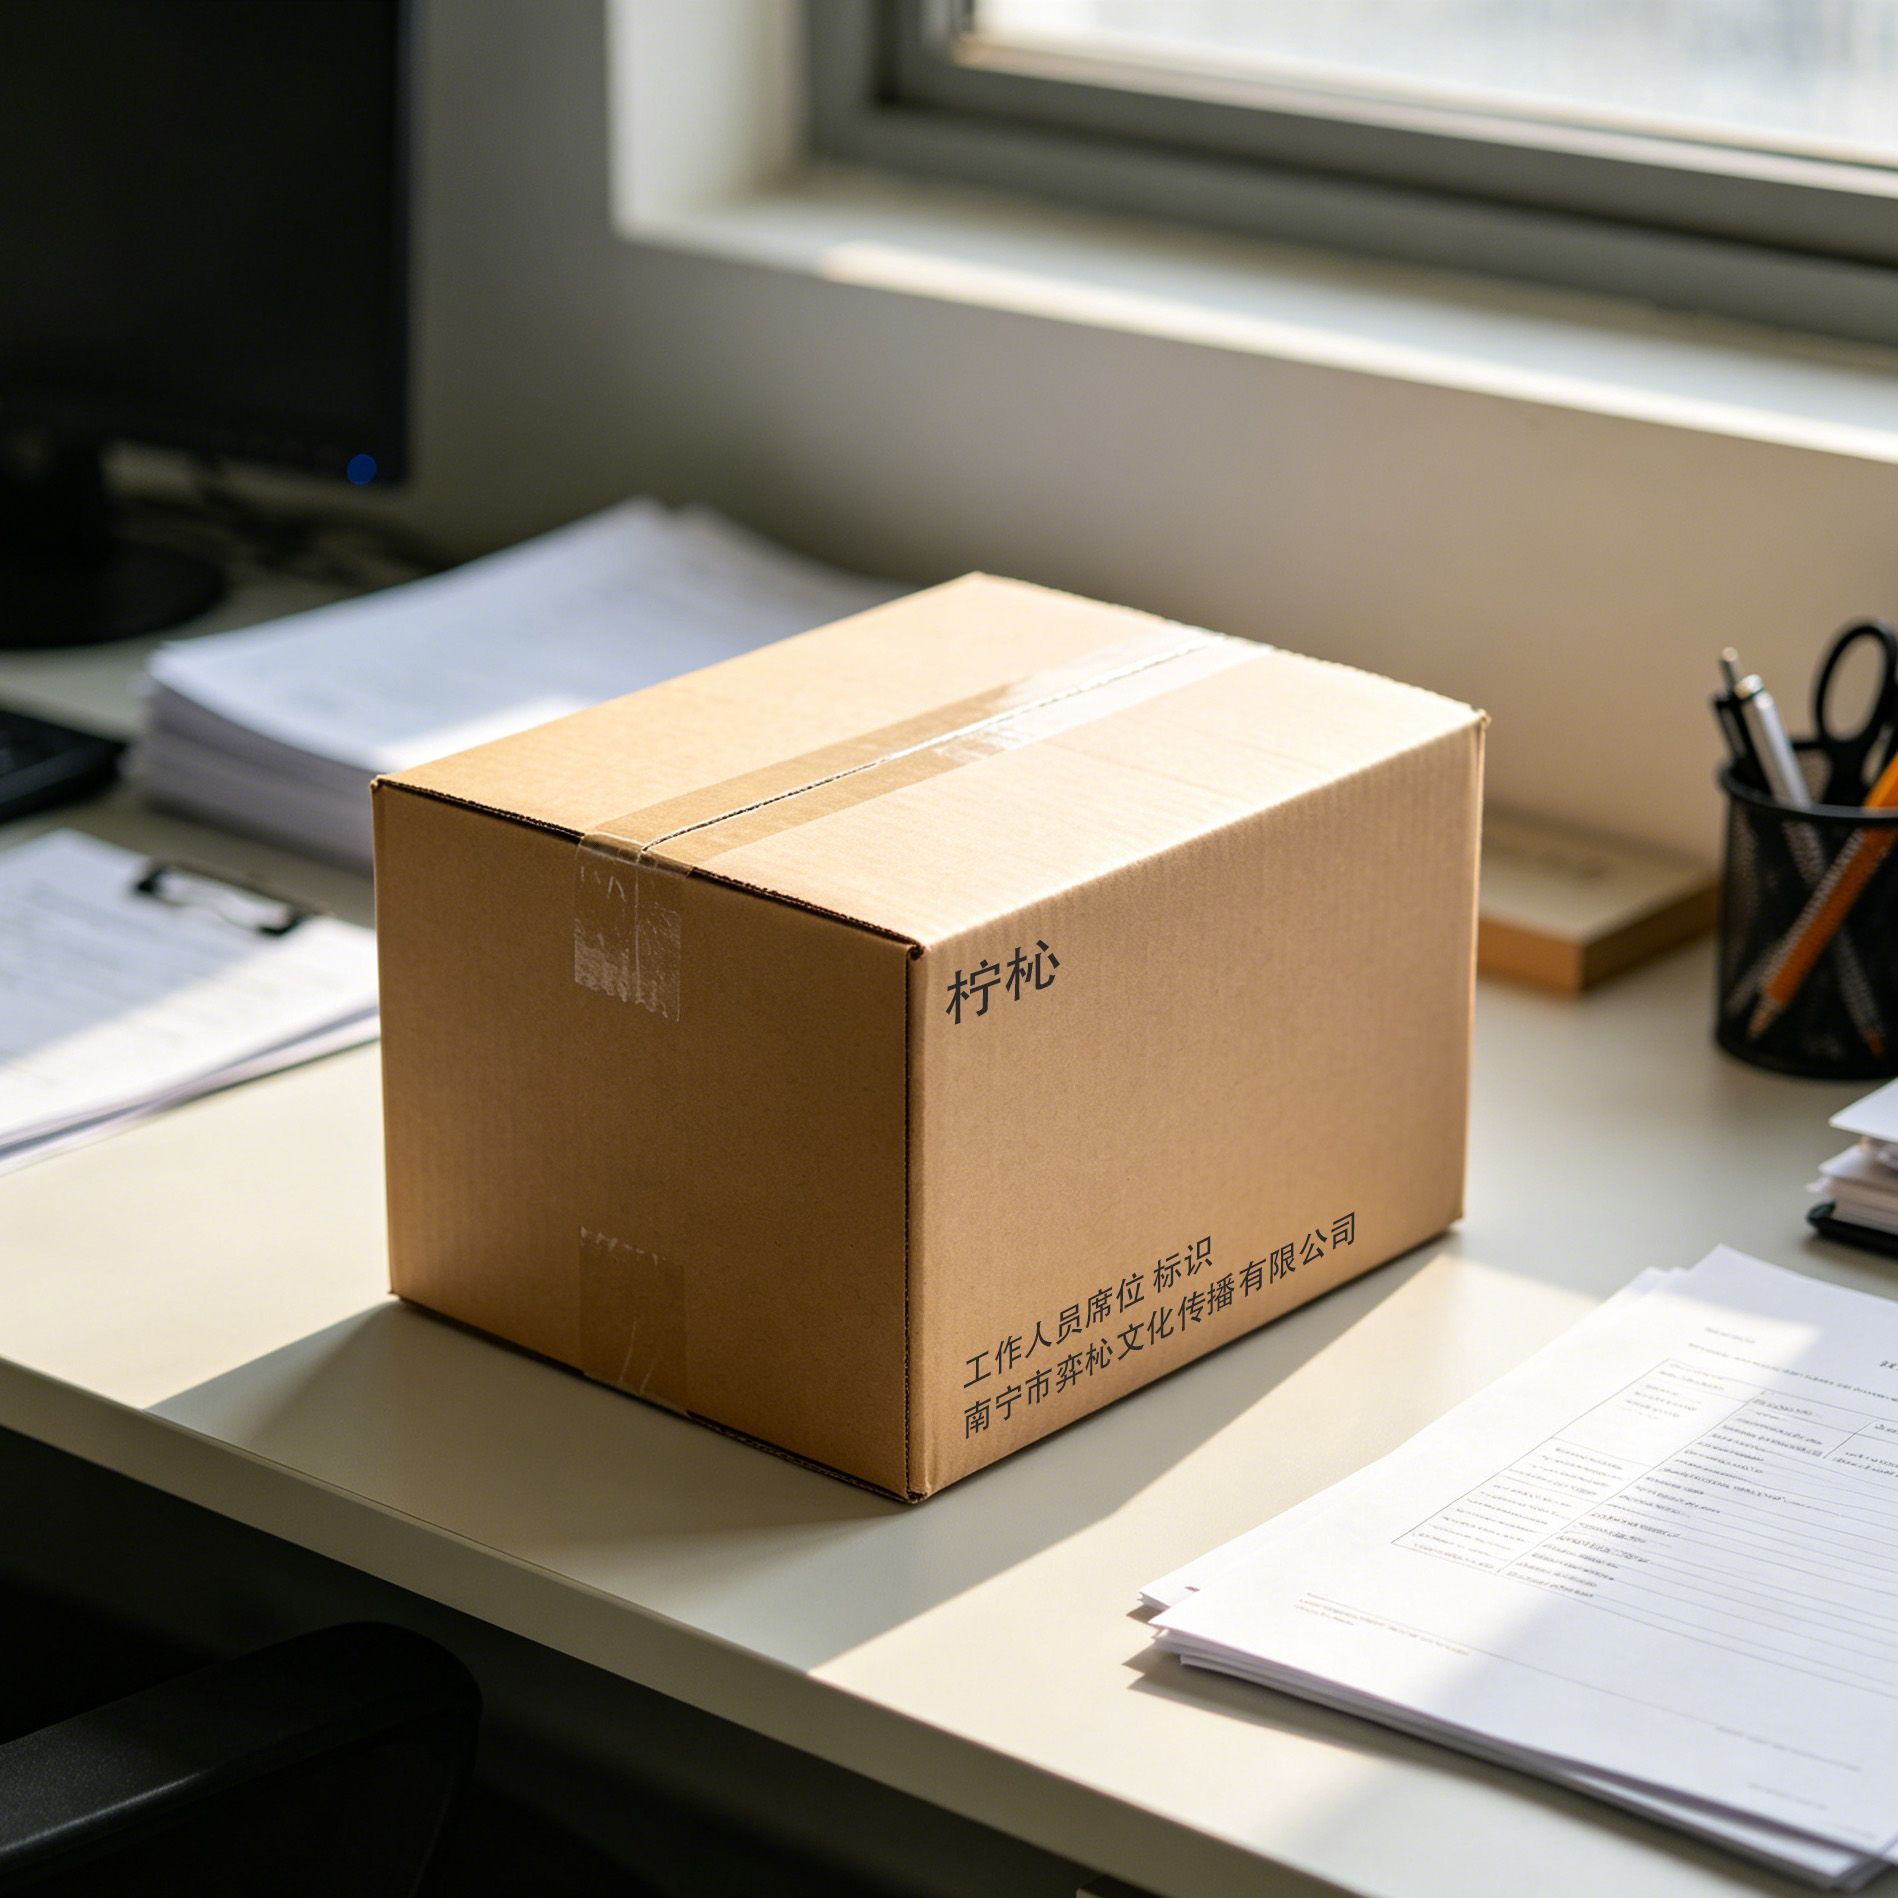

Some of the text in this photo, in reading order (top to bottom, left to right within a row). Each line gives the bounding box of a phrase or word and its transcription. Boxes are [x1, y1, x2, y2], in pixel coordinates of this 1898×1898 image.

[963, 1235, 1213, 1389] 工作人员席位 标识
